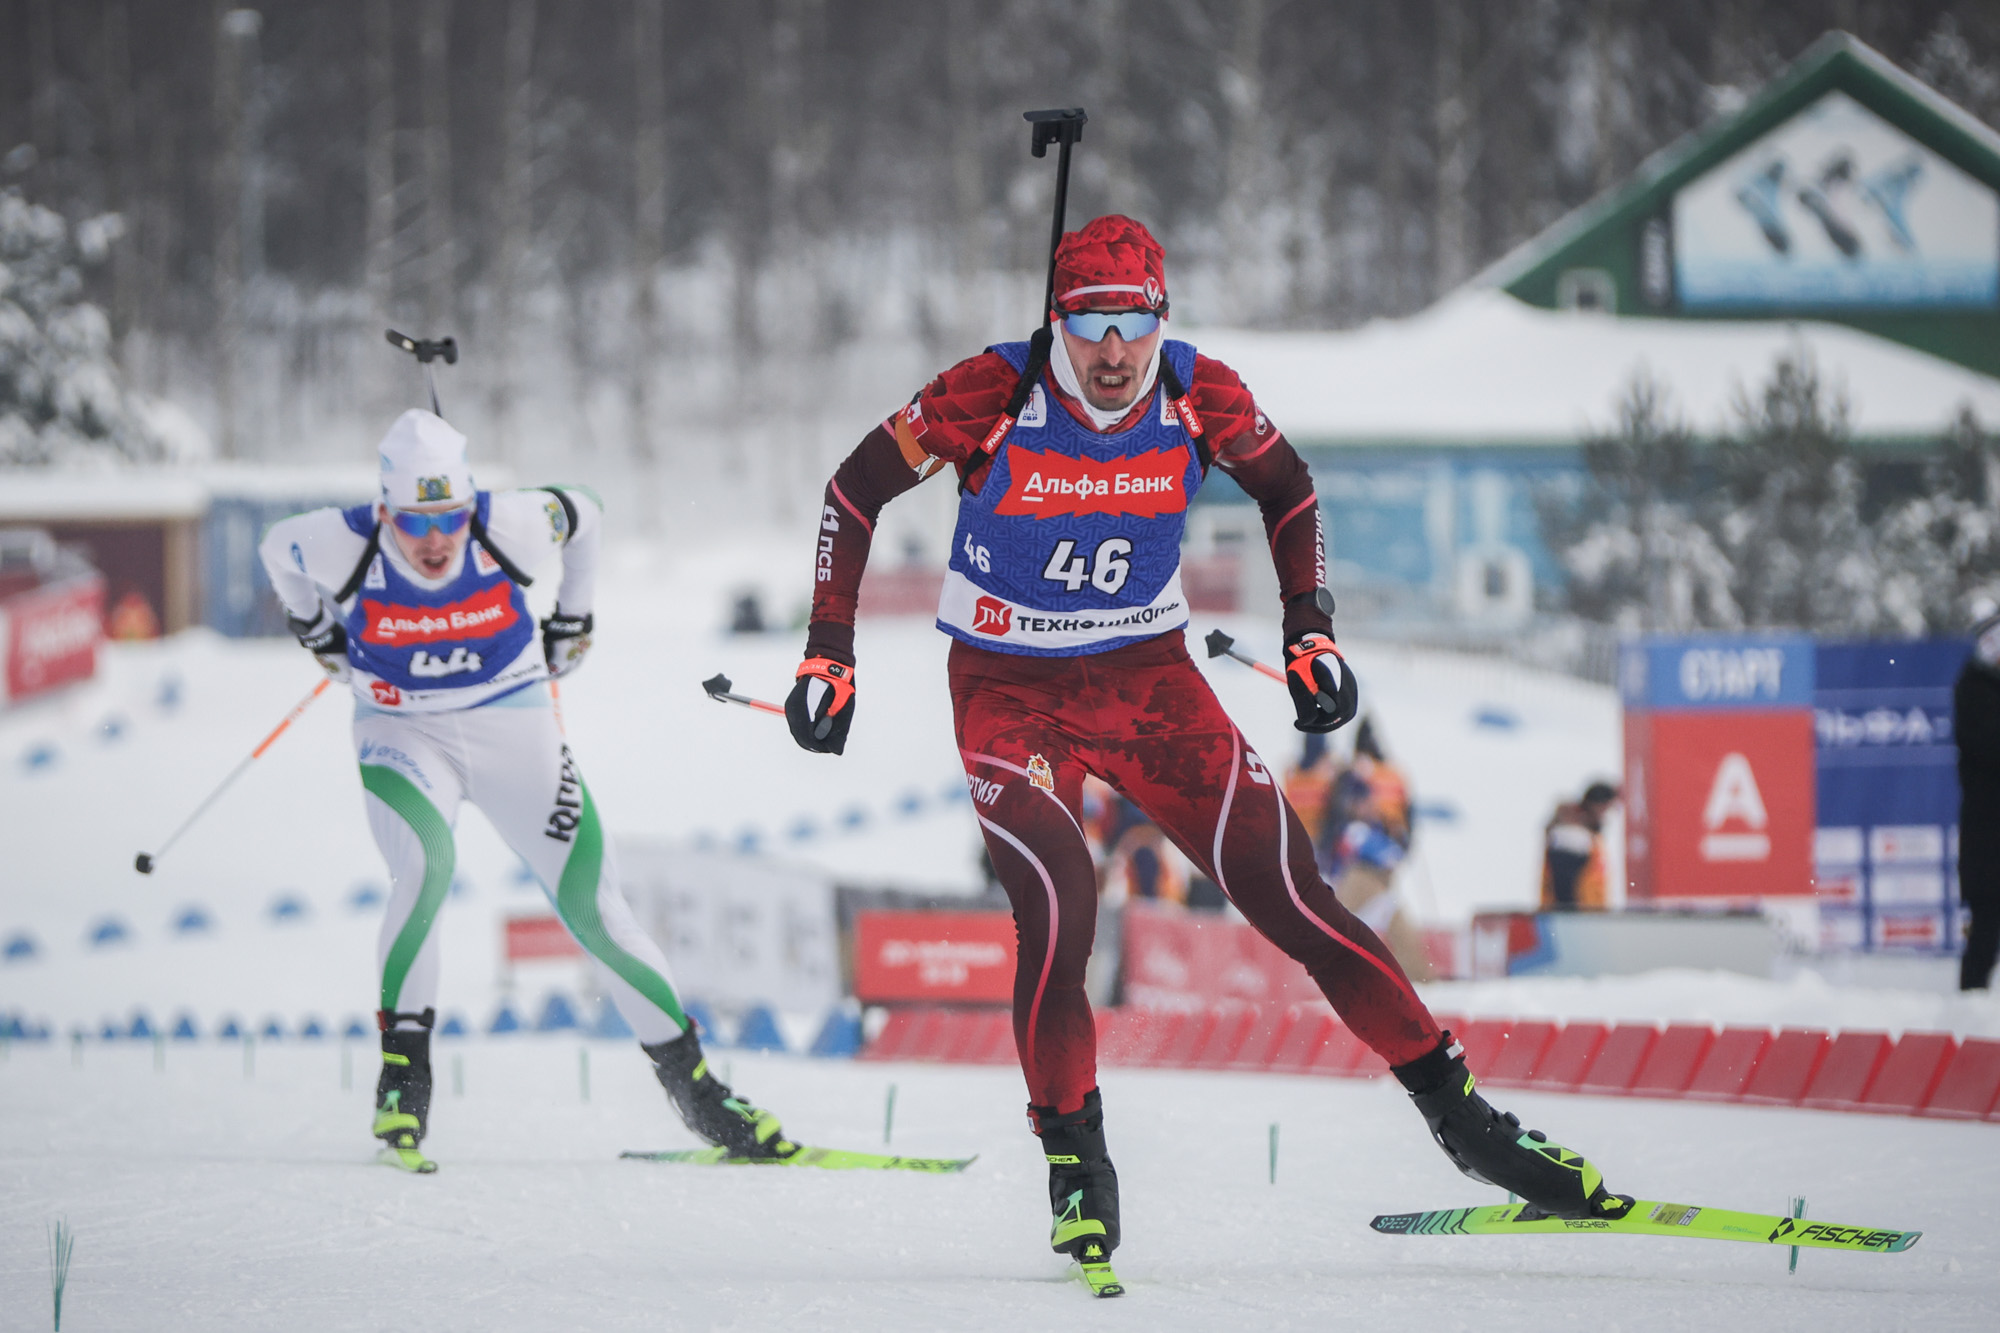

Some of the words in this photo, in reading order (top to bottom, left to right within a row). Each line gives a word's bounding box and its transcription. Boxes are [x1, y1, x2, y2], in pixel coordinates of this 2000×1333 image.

[1165, 408, 1179, 420] 20
[986, 418, 1013, 451] FANLIFE
[1021, 471, 1110, 502] Альфа
[1114, 472, 1174, 495] Банк
[817, 535, 834, 582] ПСБ
[963, 532, 992, 574] 46
[1043, 537, 1134, 596] 46
[376, 615, 450, 639] Альфа
[450, 604, 504, 630] Банк
[409, 647, 484, 678] 44
[967, 773, 1005, 806] РТИЯ
[1565, 1220, 1612, 1229] FISCHER
[1797, 1224, 1903, 1249] FISCHER
